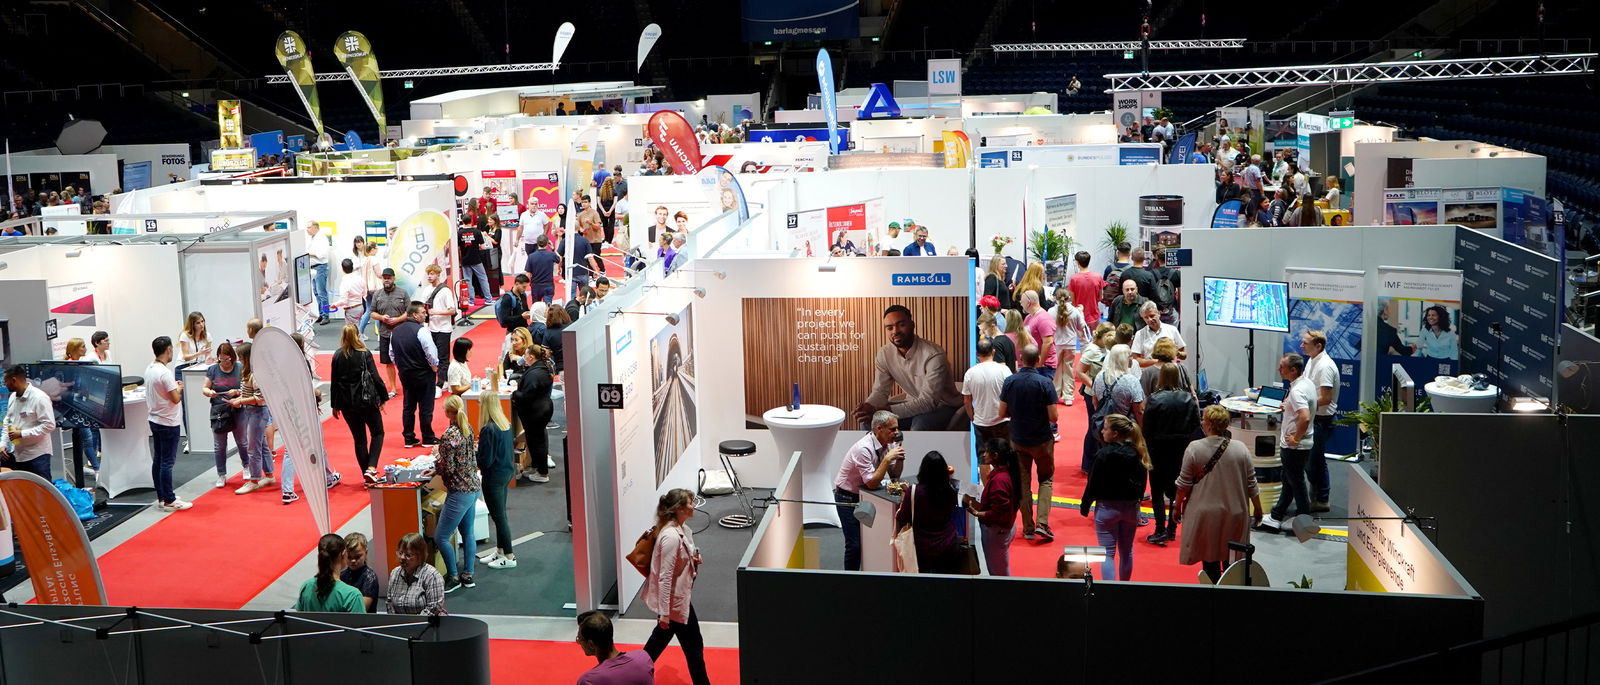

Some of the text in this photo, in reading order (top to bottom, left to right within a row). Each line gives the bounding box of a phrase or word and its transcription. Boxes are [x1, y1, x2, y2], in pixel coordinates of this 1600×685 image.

[932, 71, 955, 83] LSW
[1554, 214, 1563, 222] 15
[1291, 281, 1307, 289] IMF
[1384, 280, 1401, 289] IMF
[815, 309, 845, 318] every
[797, 319, 836, 329] project
[46, 323, 57, 336] 06
[797, 330, 865, 341] can push for
[797, 342, 859, 351] sustainable
[600, 390, 621, 403] 09
[1357, 527, 1404, 591] und Energiewende
[1379, 528, 1387, 548] für
[1387, 538, 1415, 582] Windkraft
